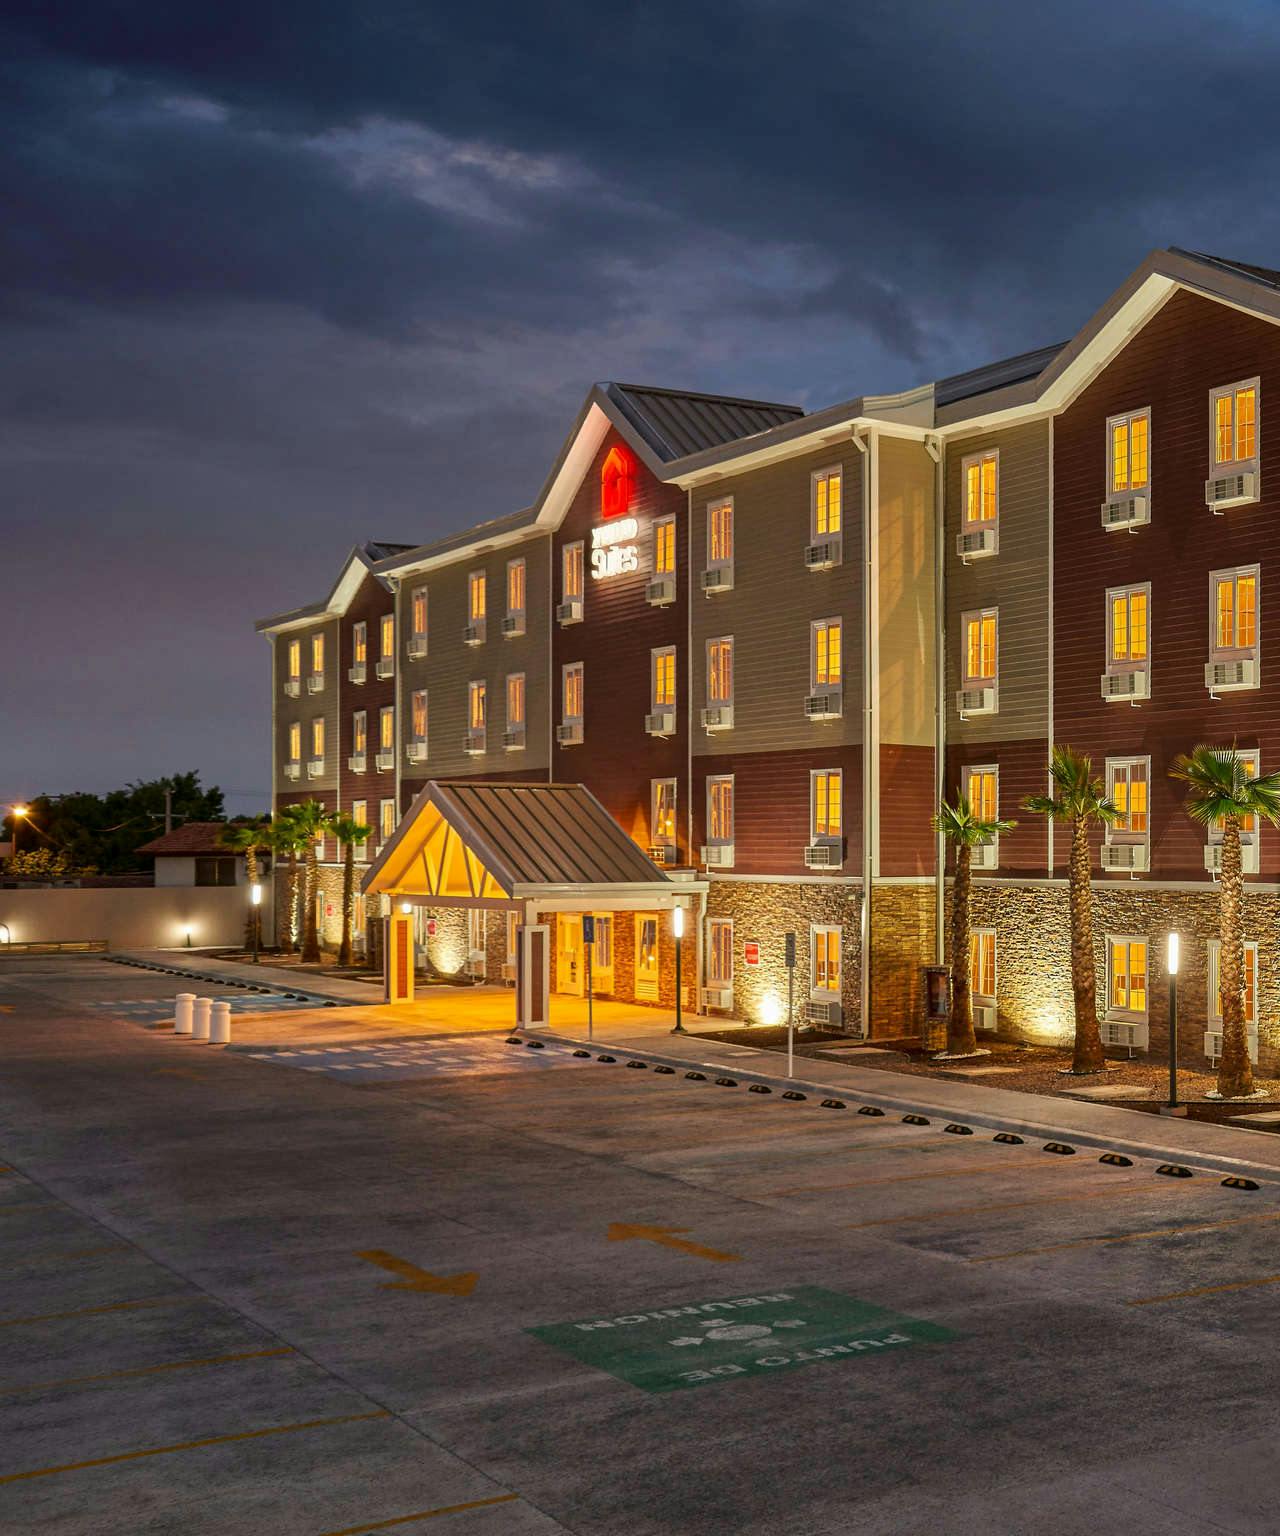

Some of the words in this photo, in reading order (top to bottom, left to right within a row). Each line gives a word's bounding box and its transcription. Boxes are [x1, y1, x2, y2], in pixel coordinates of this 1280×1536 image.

[576, 1294, 795, 1331] REUNION
[755, 1333, 912, 1367] PUNTO
[677, 1363, 748, 1381] DE
